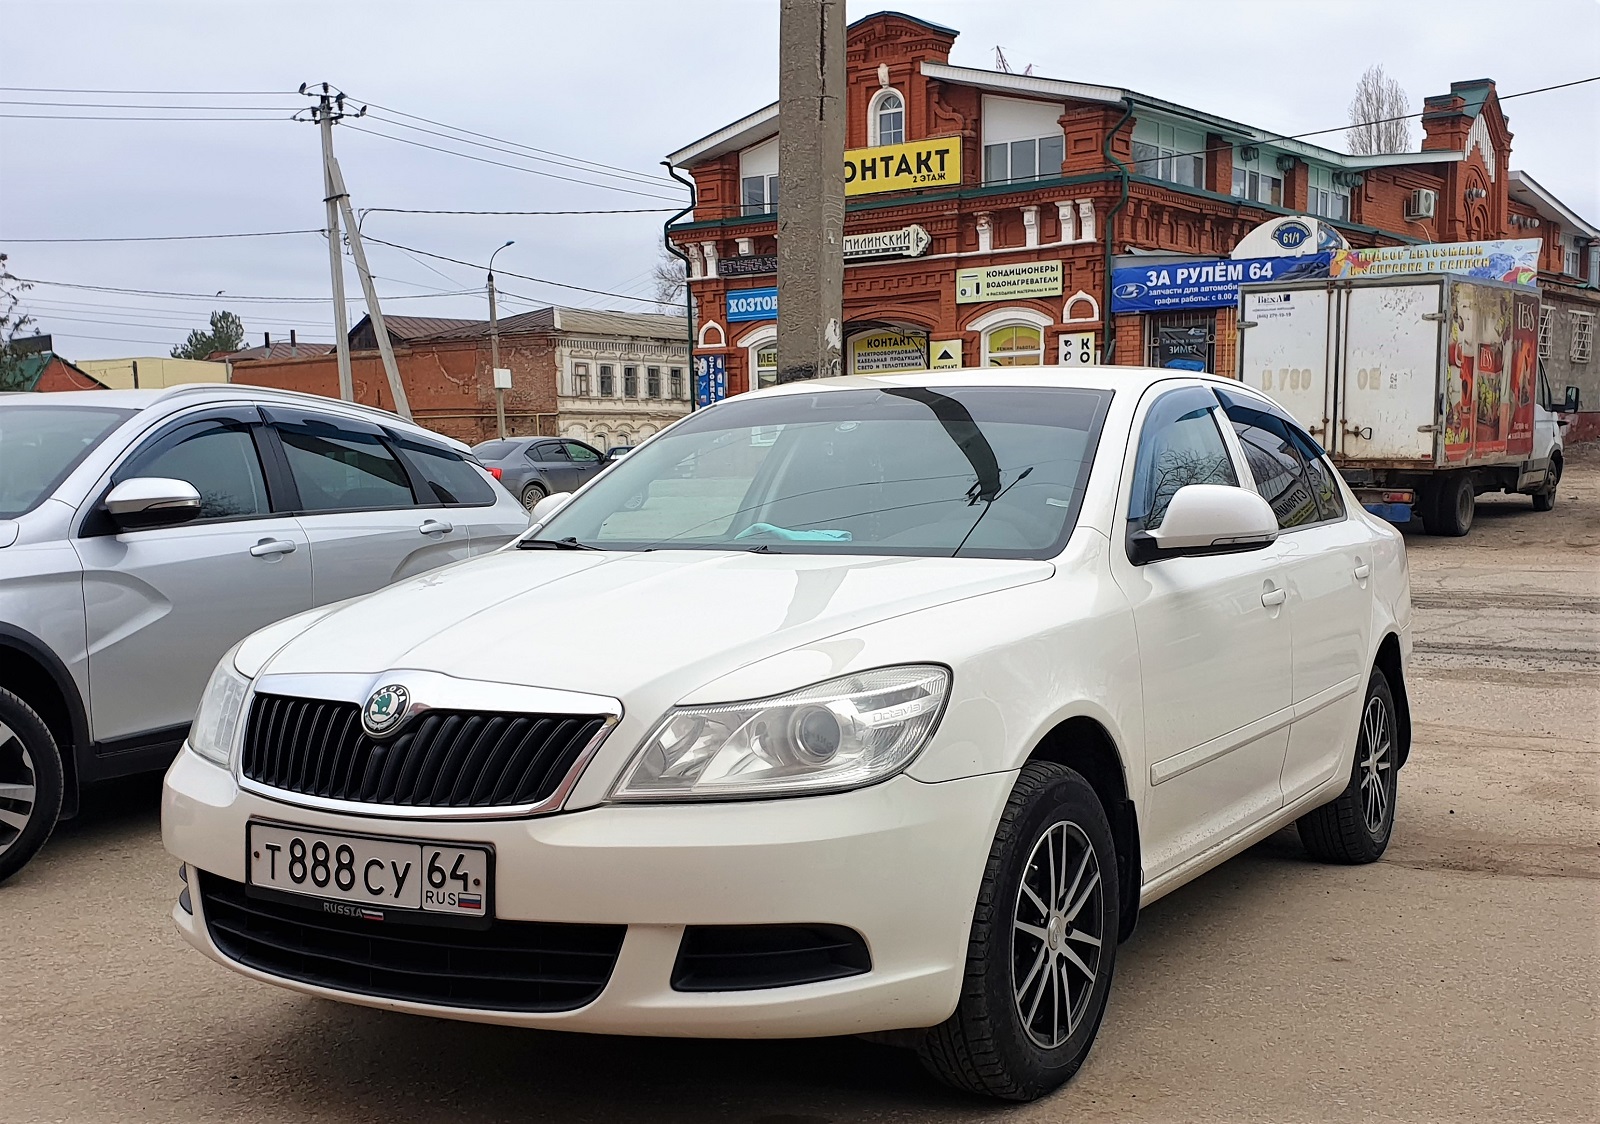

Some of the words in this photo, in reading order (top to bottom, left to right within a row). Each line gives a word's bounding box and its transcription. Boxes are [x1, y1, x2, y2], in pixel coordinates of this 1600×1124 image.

[919, 172, 946, 182] ЭТАЖ
[844, 229, 910, 251] МИЛИНСКИЙ
[1283, 231, 1300, 244] 61/1
[986, 264, 1059, 278] КОНДИЦИОНЕРЫ
[1146, 270, 1171, 287] ЗА
[1177, 262, 1243, 285] РУЛЁМ
[1249, 261, 1273, 279] 64
[986, 276, 1058, 288] ВОДОНАГРЕВАТЕЛИ
[1148, 288, 1183, 296] запчасти
[1183, 286, 1199, 294] для
[1154, 296, 1180, 306] график
[1181, 294, 1211, 304] работы:
[1517, 302, 1535, 332] TESS
[867, 336, 911, 349] КОНТАКТ
[427, 851, 469, 892] 64
[425, 890, 456, 905] RUS
[323, 902, 363, 918] RUSSIA
